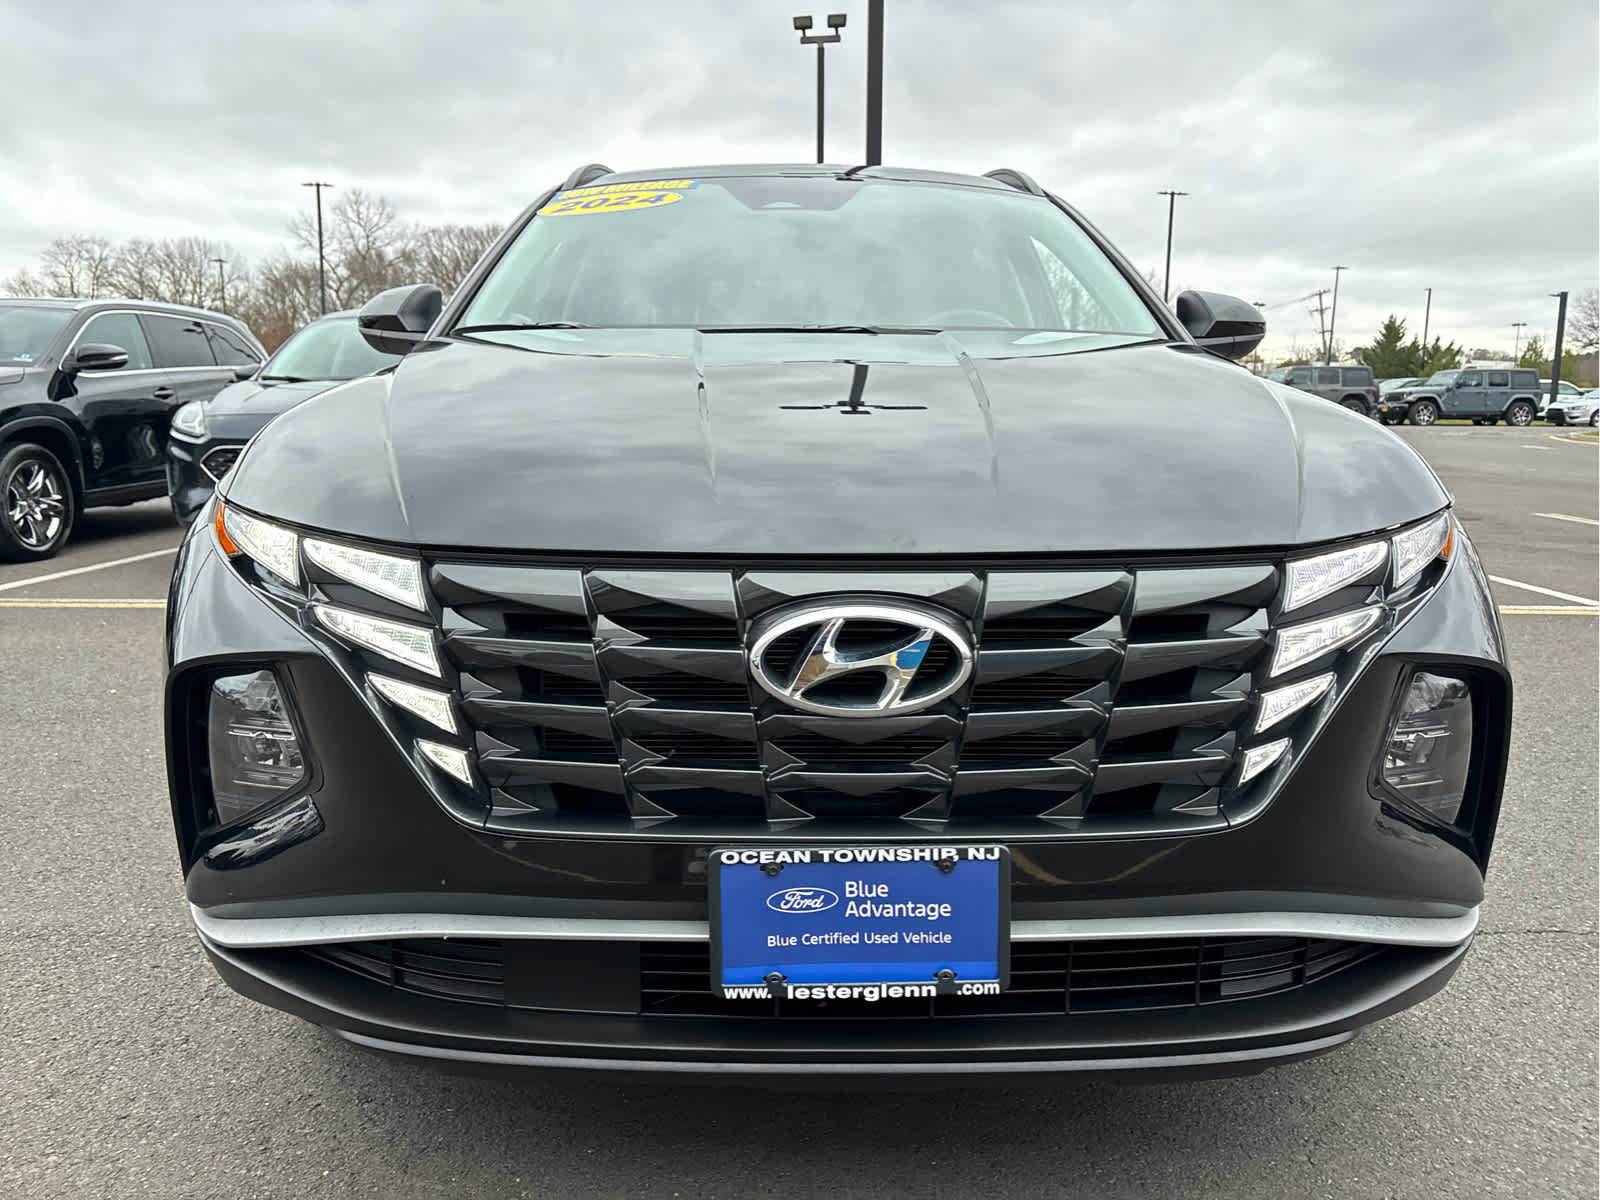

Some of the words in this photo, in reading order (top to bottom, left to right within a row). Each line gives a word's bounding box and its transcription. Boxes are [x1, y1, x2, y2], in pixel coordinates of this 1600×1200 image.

[604, 180, 695, 193] MILEAGE
[552, 194, 667, 213] 2024
[720, 850, 811, 865] OCEAN
[967, 847, 1000, 861] NJ
[845, 880, 889, 898] Blue
[780, 890, 825, 910] Ford
[844, 900, 953, 921] Advantage
[767, 934, 798, 948] Blue
[801, 931, 860, 946] Certified
[864, 931, 899, 945] Used
[902, 931, 953, 944] Vehicle
[723, 986, 773, 1000] www.
[786, 983, 937, 1001] lesterglenn
[957, 982, 1000, 996] .com
